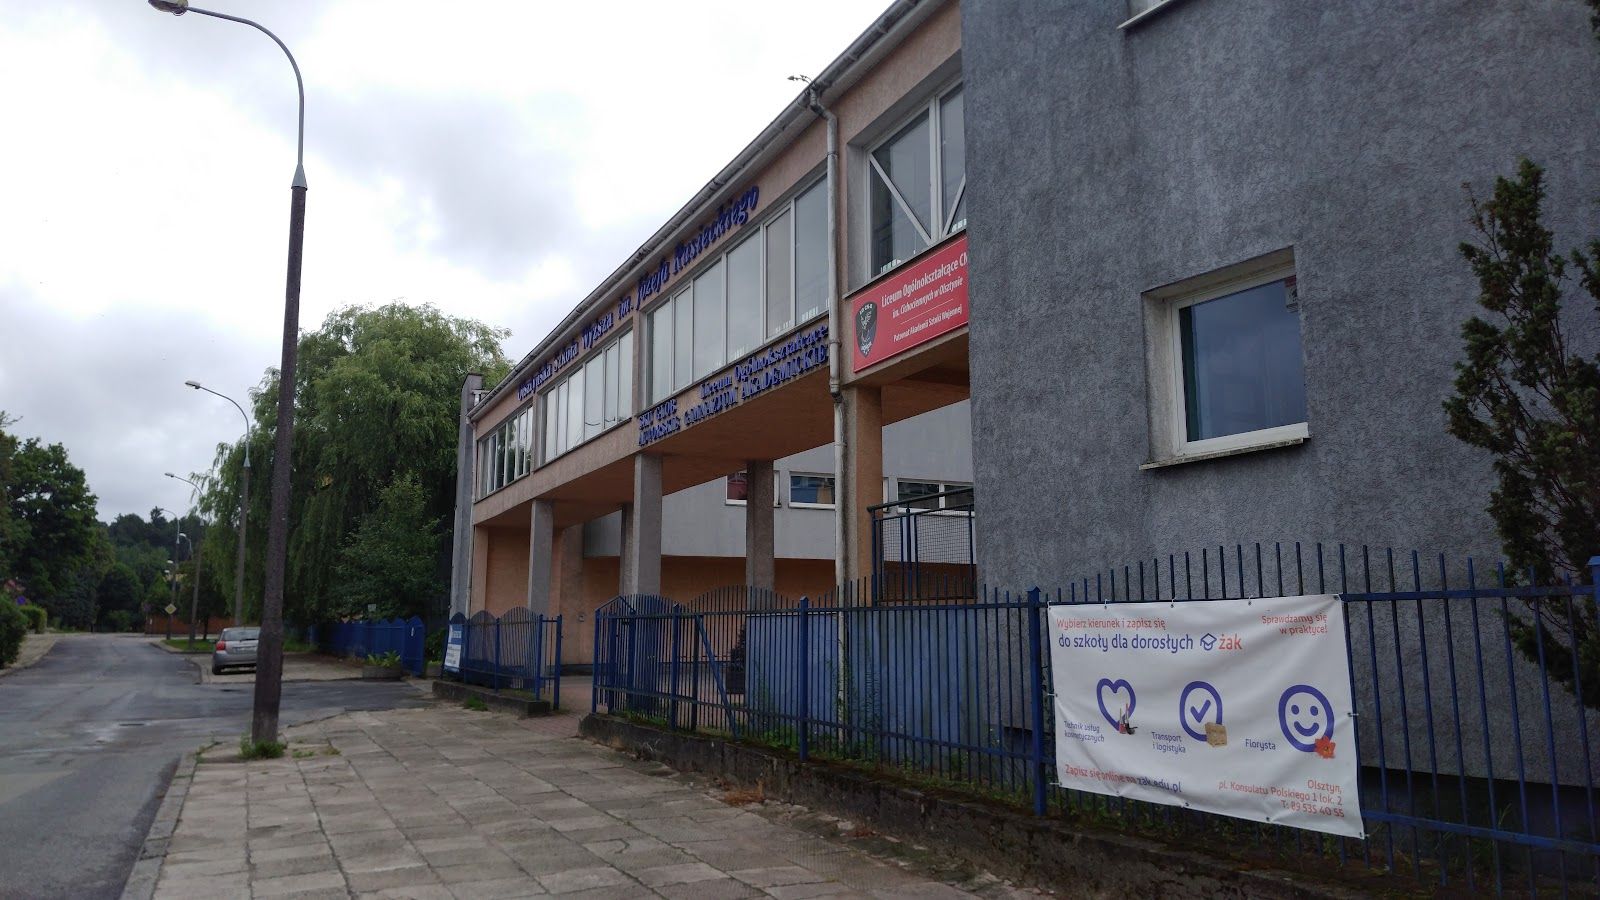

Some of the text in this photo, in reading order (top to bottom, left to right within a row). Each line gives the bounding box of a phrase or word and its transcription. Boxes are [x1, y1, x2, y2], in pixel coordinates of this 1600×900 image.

[882, 289, 902, 308] Liceum
[1056, 618, 1086, 630] Wybierz
[1088, 618, 1120, 628] kierunek
[1127, 618, 1152, 630] zapisz
[1154, 618, 1166, 630] się
[1261, 613, 1327, 625] Sprawdzamy się
[1058, 634, 1194, 654] do szkoły dla dorosłych
[1218, 634, 1242, 650] żak
[1152, 732, 1182, 743] Transport
[1156, 743, 1186, 754] logistyka
[1245, 738, 1276, 751] Florysta
[1065, 764, 1088, 777] Zapisz
[1230, 782, 1268, 795] Konsulatu
[1271, 786, 1310, 801] Polskiego
[1320, 794, 1334, 804] lok.
[1308, 780, 1342, 794] Olsztyn,
[1302, 804, 1317, 814] 535
[1320, 806, 1331, 816] 40
[1333, 808, 1344, 818] 55
